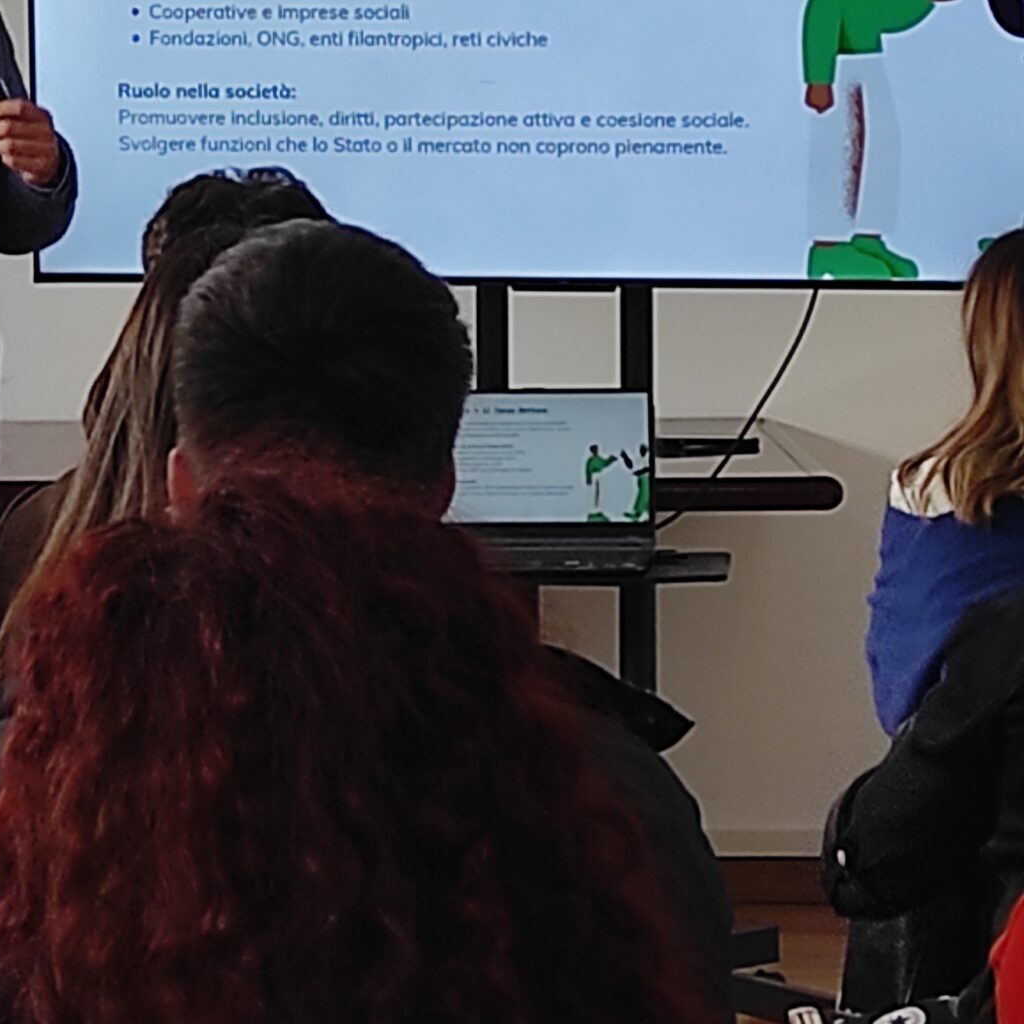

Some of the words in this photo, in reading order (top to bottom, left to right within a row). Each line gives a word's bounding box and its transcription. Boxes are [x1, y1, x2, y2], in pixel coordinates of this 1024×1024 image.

[149, 3, 257, 24] Cooperative
[262, 8, 272, 20] e
[278, 4, 349, 24] imprese
[354, 3, 410, 20] sociali
[309, 31, 343, 46] enti
[348, 30, 447, 52] filantropici,
[452, 32, 482, 48] reti
[486, 31, 548, 48] civiche
[118, 82, 171, 99] Ruolo
[176, 82, 220, 99] nella
[225, 82, 296, 100] società:
[119, 109, 226, 125] Promuovere
[231, 109, 323, 127] inclusione,
[384, 111, 518, 131] partecipazione
[523, 112, 575, 127] attiva
[580, 115, 591, 127] e
[596, 113, 676, 128] coesione
[681, 112, 749, 128] sociale.
[119, 136, 196, 156] Svolgere
[201, 135, 271, 152] funzioni
[276, 136, 308, 153] che
[313, 136, 328, 153] lo
[333, 137, 382, 153] Stato
[386, 140, 398, 153] o
[403, 136, 412, 152] il
[418, 139, 492, 154] mercato
[497, 142, 531, 154] non
[615, 139, 727, 158] pienamente.
